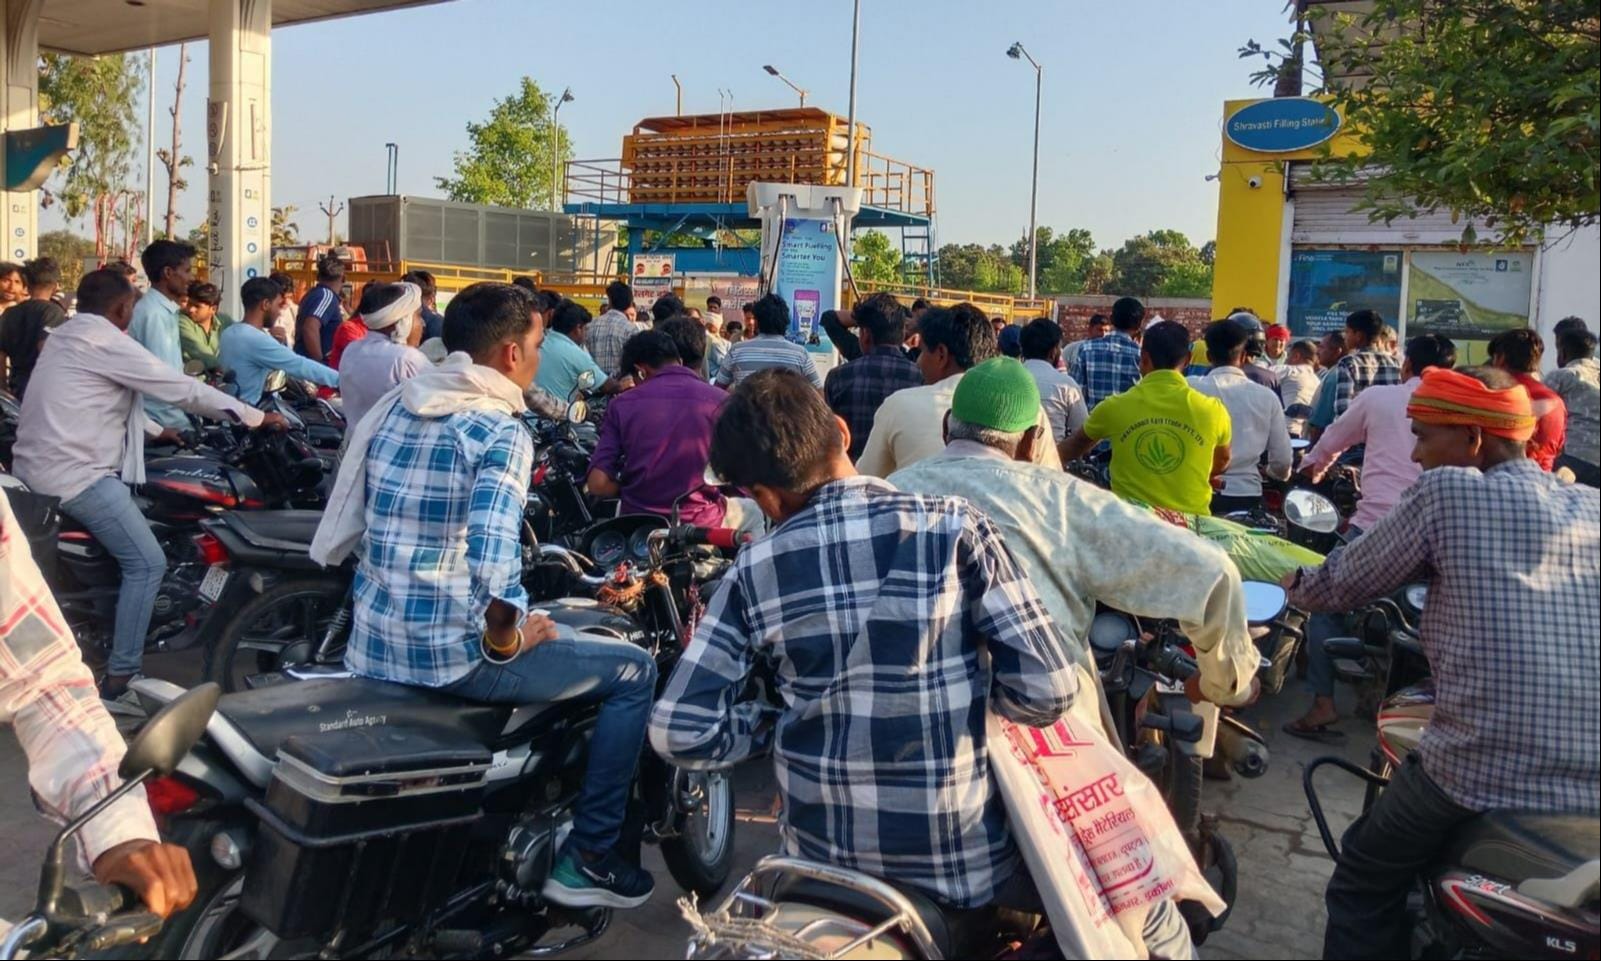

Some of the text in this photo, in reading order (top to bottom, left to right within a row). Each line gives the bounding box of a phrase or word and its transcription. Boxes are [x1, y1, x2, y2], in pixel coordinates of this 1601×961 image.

[1233, 122, 1272, 131] Shravasti
[1274, 119, 1300, 129] Filling
[805, 242, 833, 251] Fuelling
[782, 252, 810, 260] Smarter
[319, 718, 348, 732] Standard
[1546, 936, 1577, 953] KLS
